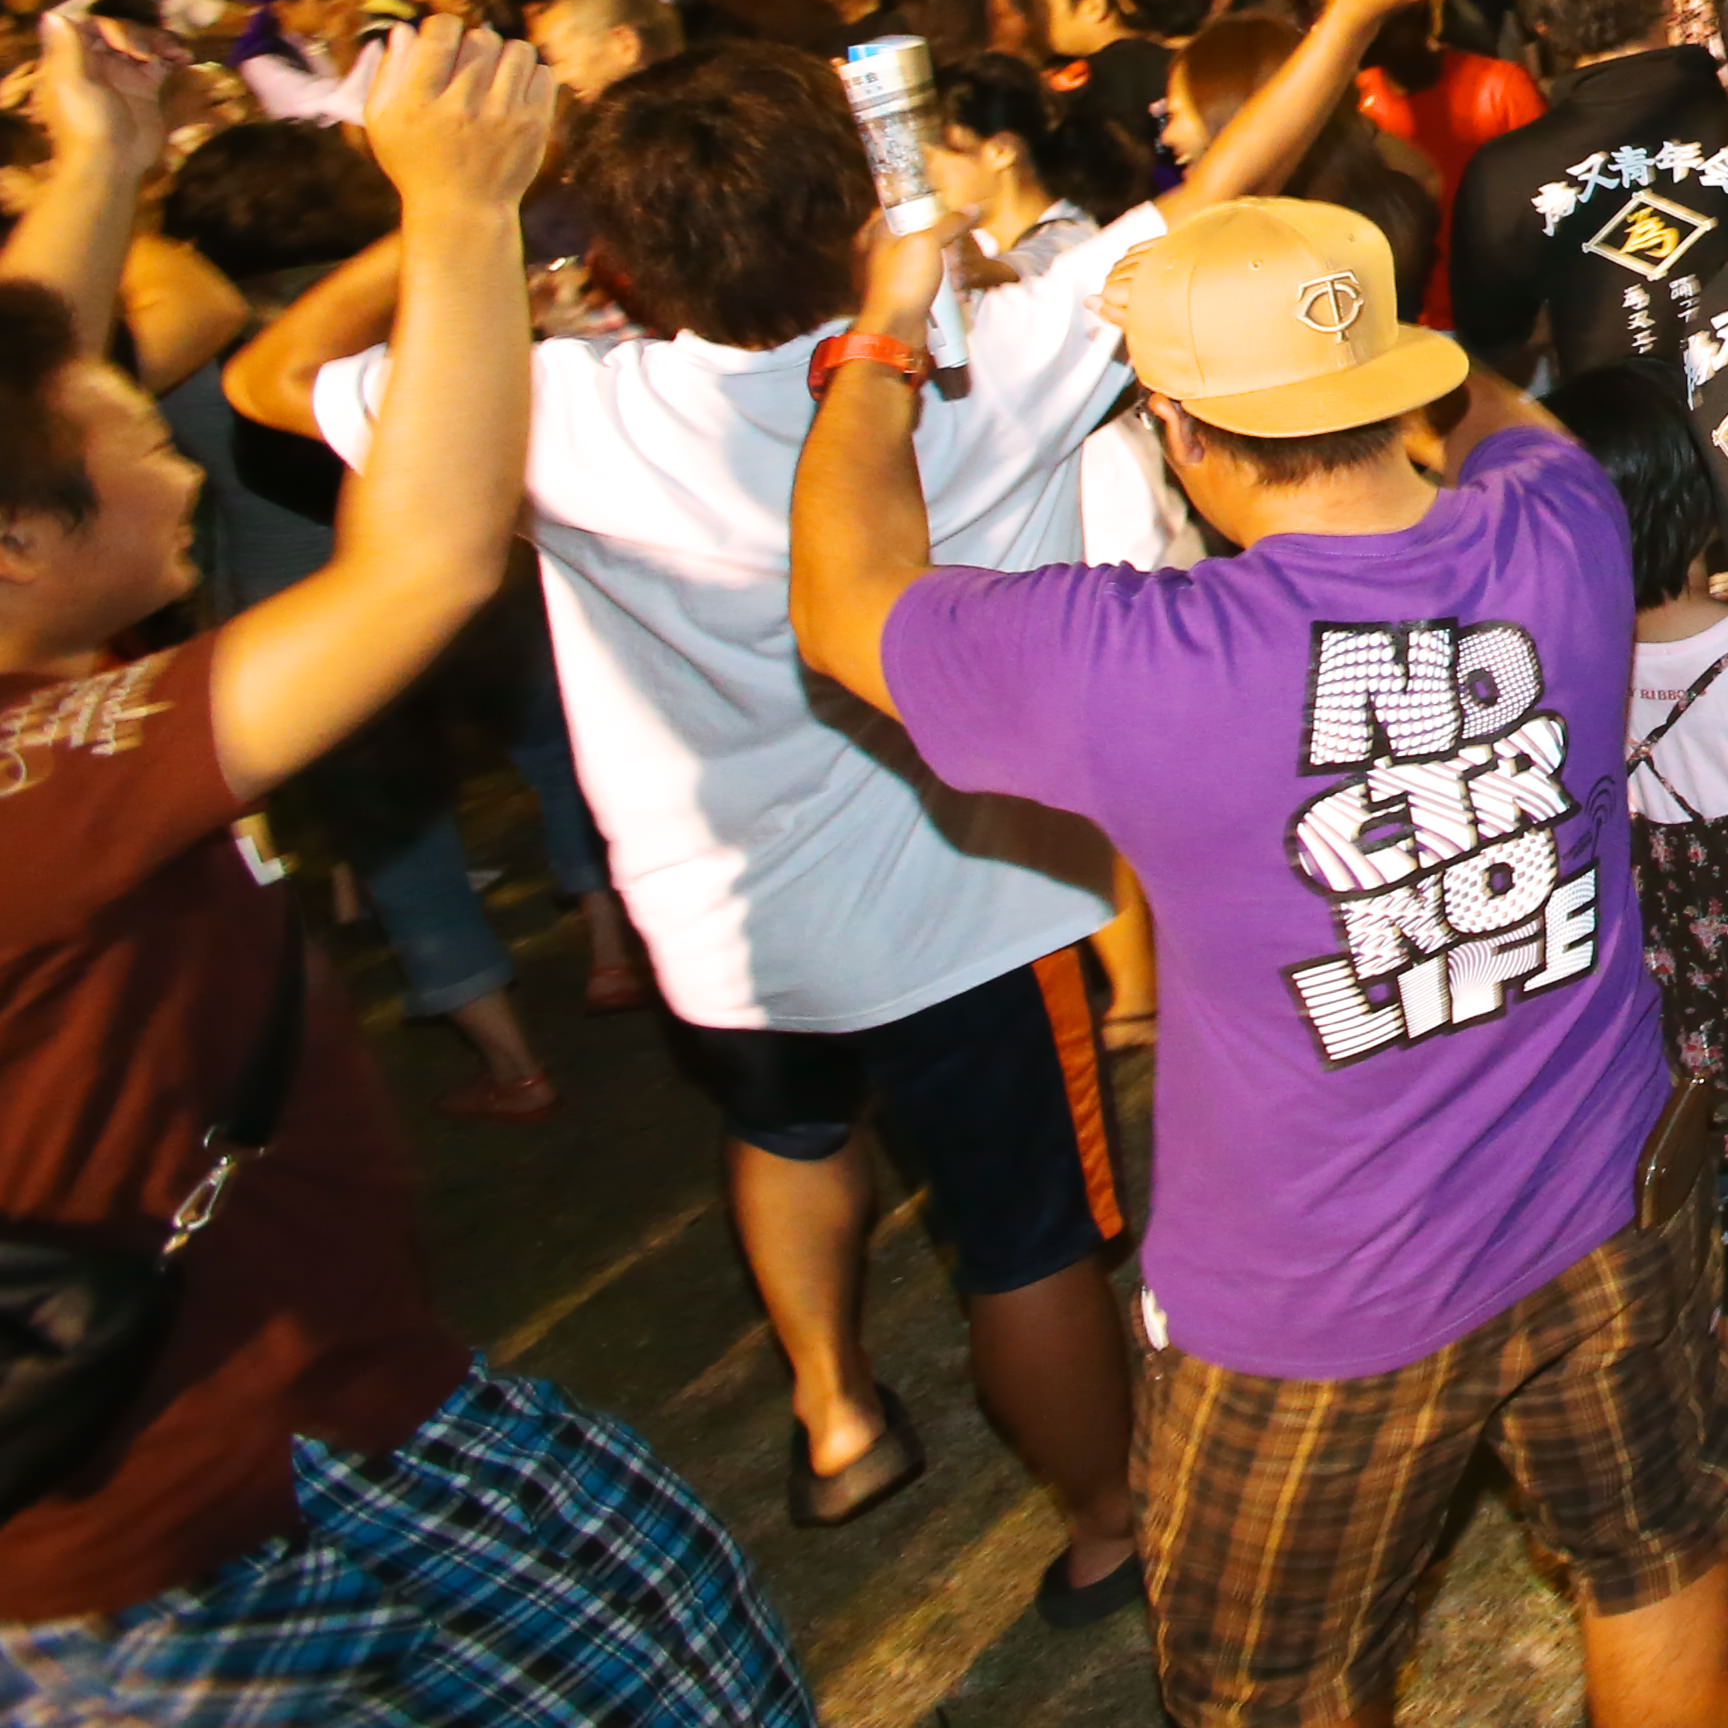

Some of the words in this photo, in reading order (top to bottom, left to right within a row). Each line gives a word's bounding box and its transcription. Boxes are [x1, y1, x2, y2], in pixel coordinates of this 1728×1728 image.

[1304, 619, 1543, 772] NO
[1639, 688, 1707, 702] RIBBO
[1286, 866, 1600, 1064] LIFE
